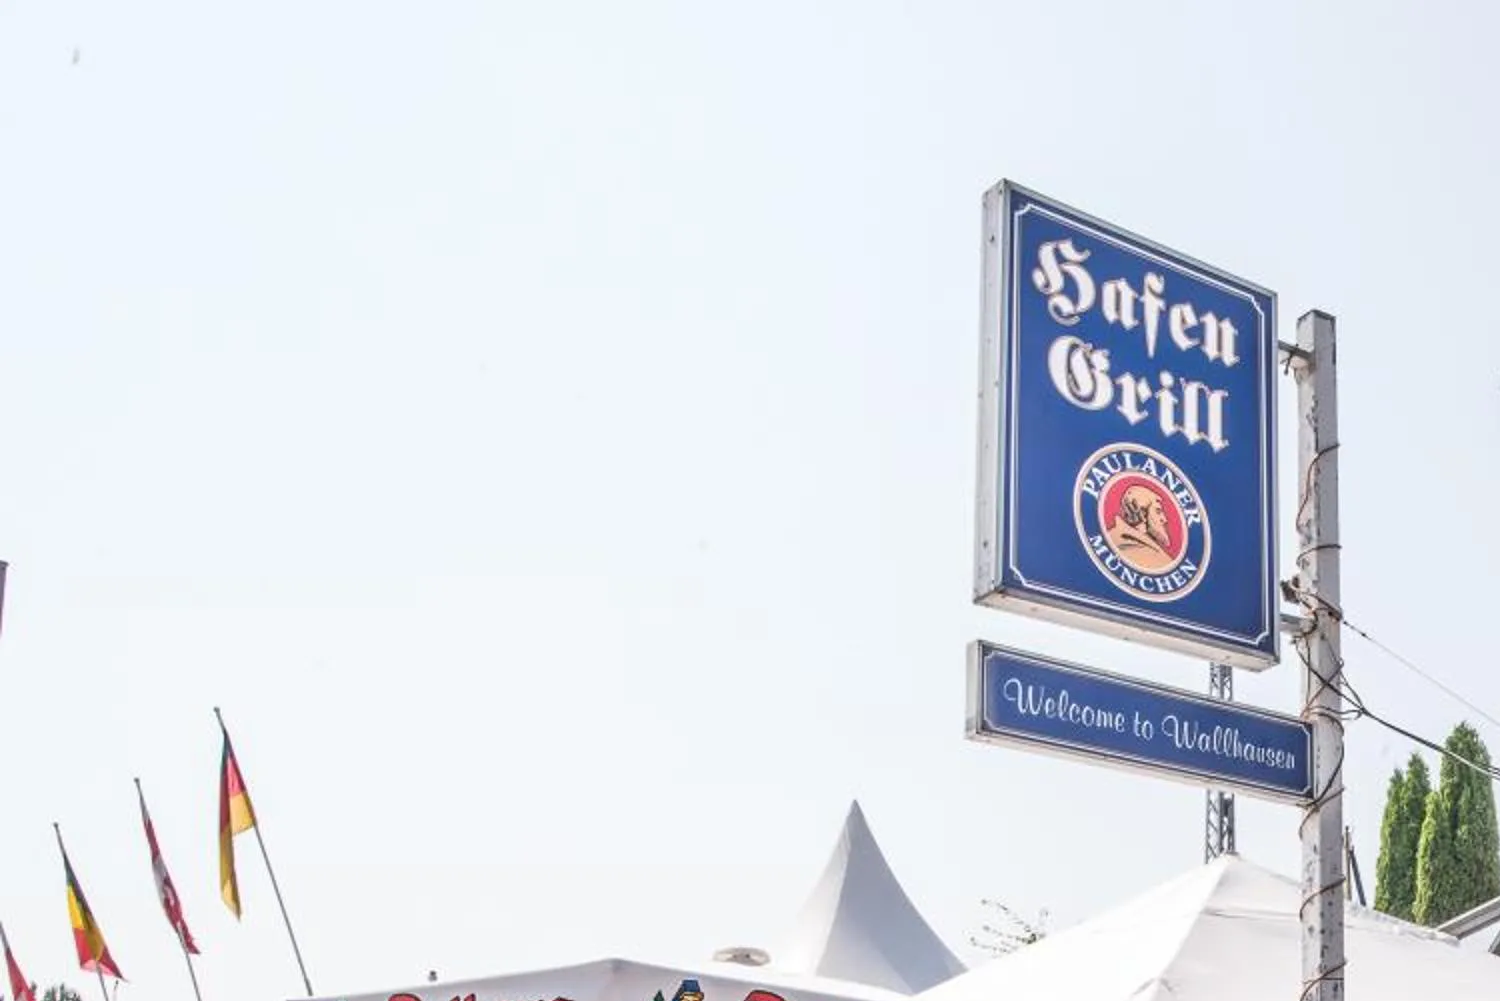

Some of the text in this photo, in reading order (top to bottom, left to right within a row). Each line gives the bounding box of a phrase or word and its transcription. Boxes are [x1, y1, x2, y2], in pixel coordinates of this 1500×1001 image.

[1032, 238, 1240, 367] Hafen
[1048, 335, 1230, 454] Grill
[1082, 452, 1201, 529] PAULANER
[1003, 677, 1296, 770] Welcome to Wallhausen
